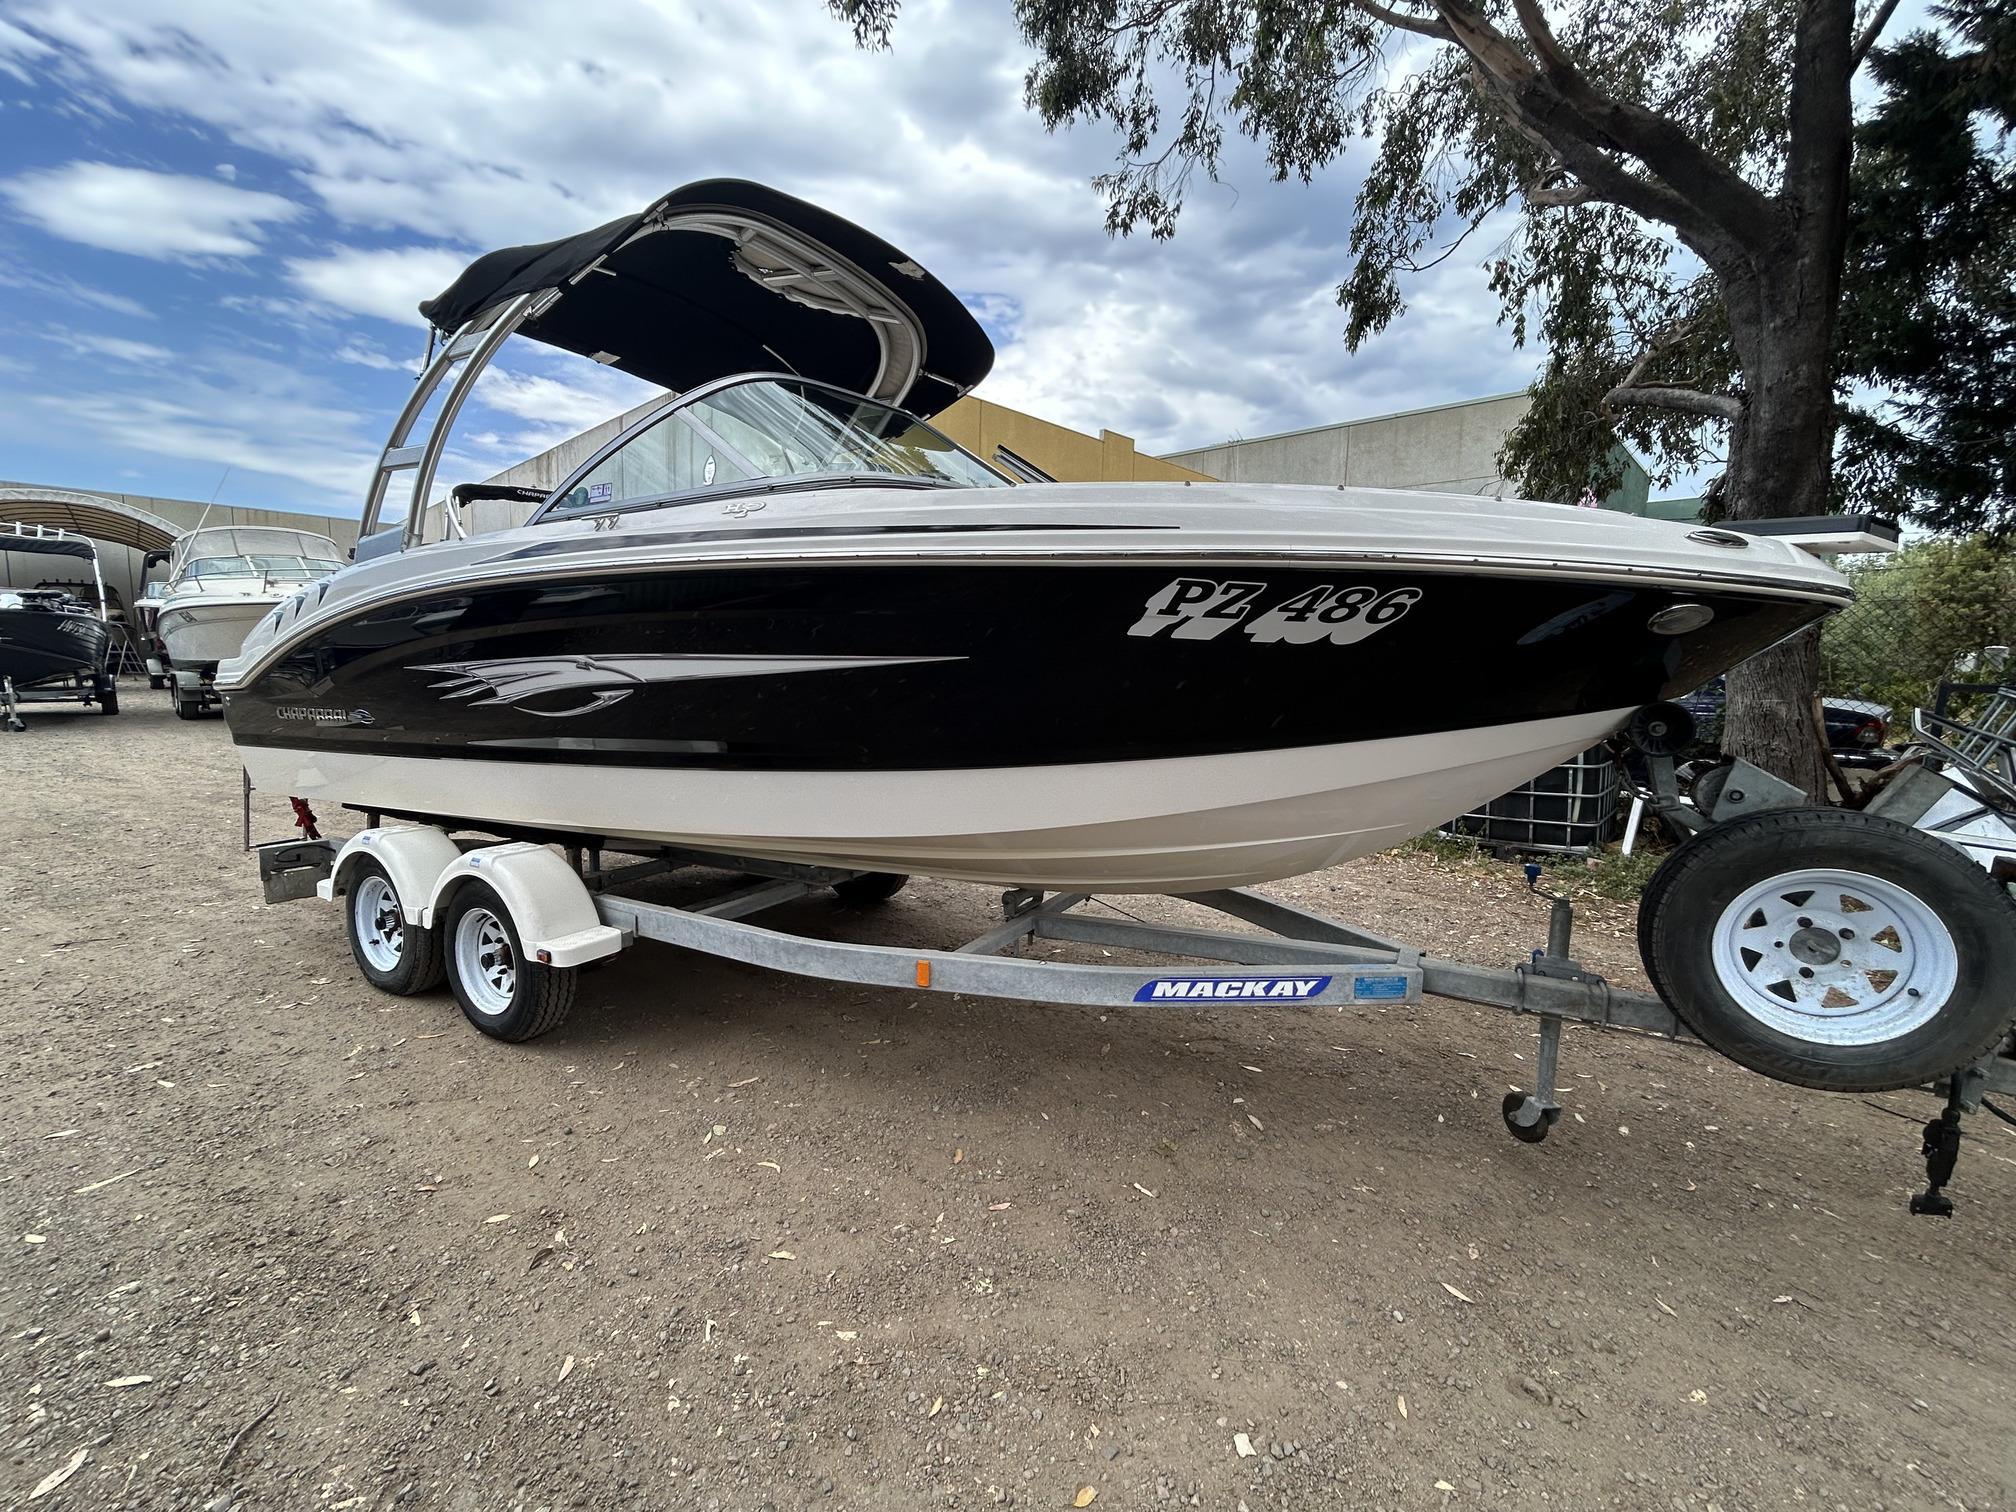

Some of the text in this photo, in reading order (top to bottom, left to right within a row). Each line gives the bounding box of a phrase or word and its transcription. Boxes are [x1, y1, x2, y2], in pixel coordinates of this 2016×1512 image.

[1134, 578, 1423, 637] PZ 486
[1152, 980, 1320, 998] MACKAY
